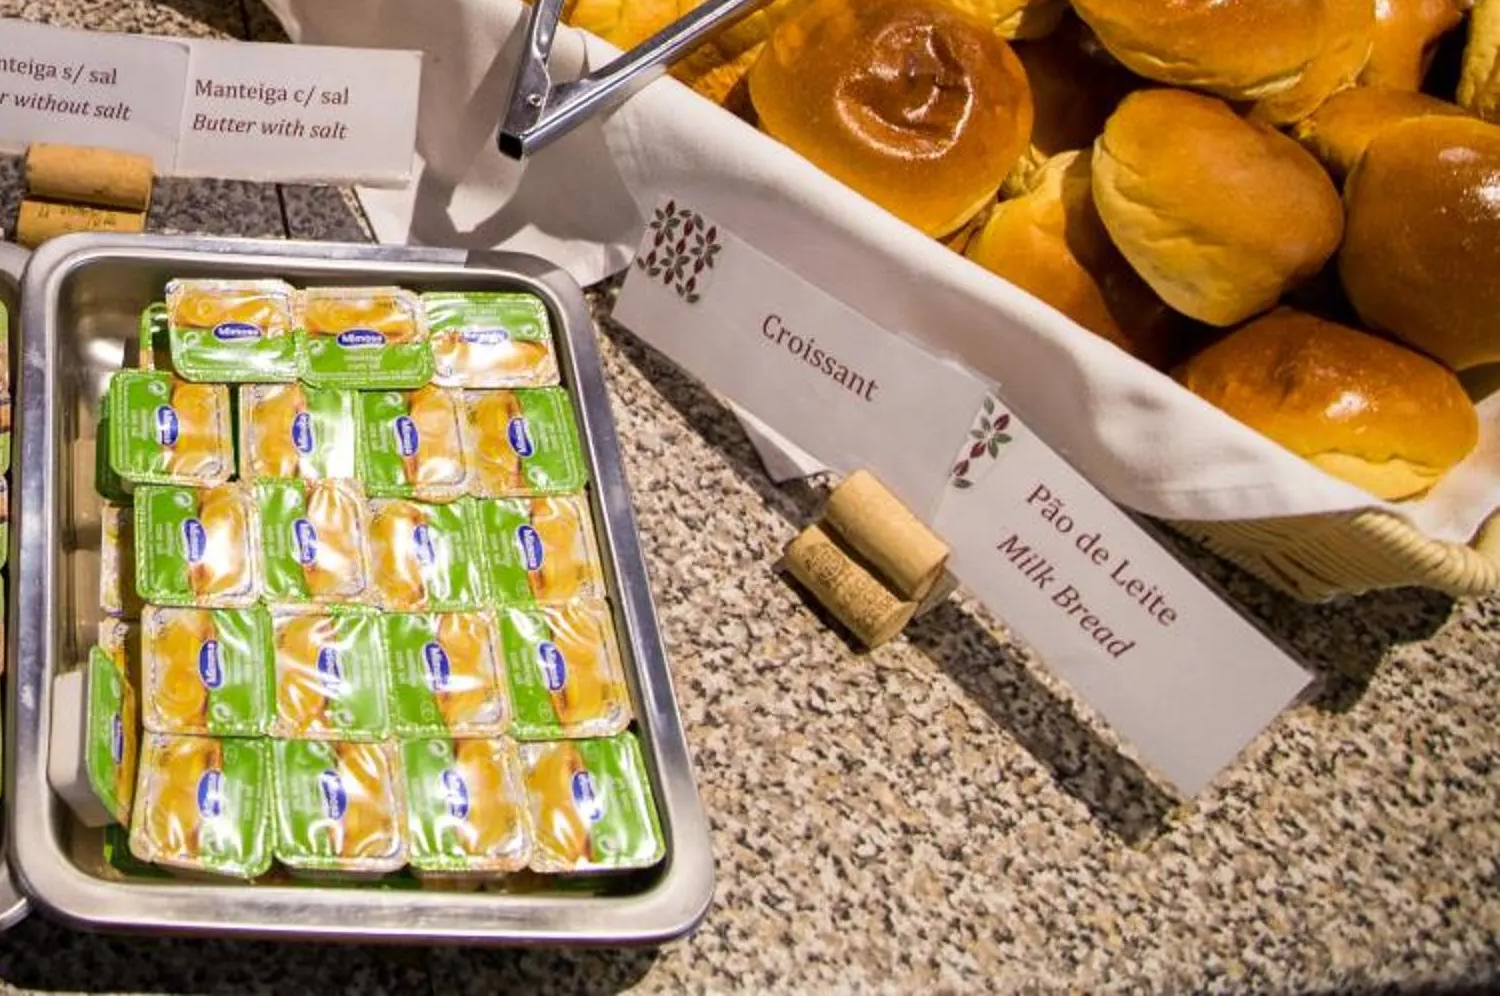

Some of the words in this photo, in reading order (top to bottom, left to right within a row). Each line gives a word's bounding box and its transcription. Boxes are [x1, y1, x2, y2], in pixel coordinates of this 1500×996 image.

[62, 64, 85, 84] s/
[88, 68, 117, 85] sal
[14, 92, 90, 116] without
[93, 102, 132, 121] salt
[194, 79, 287, 104] Manteiga
[293, 85, 317, 108] c/
[321, 86, 349, 106] sal
[192, 113, 257, 134] Butter
[261, 118, 305, 138] with
[309, 121, 348, 140] salt
[762, 314, 879, 402] Croissant
[1026, 483, 1074, 534] Pão
[1075, 533, 1110, 565] de
[1110, 559, 1178, 627] Leite
[996, 534, 1056, 590] Milk
[1051, 584, 1137, 659] Bread
